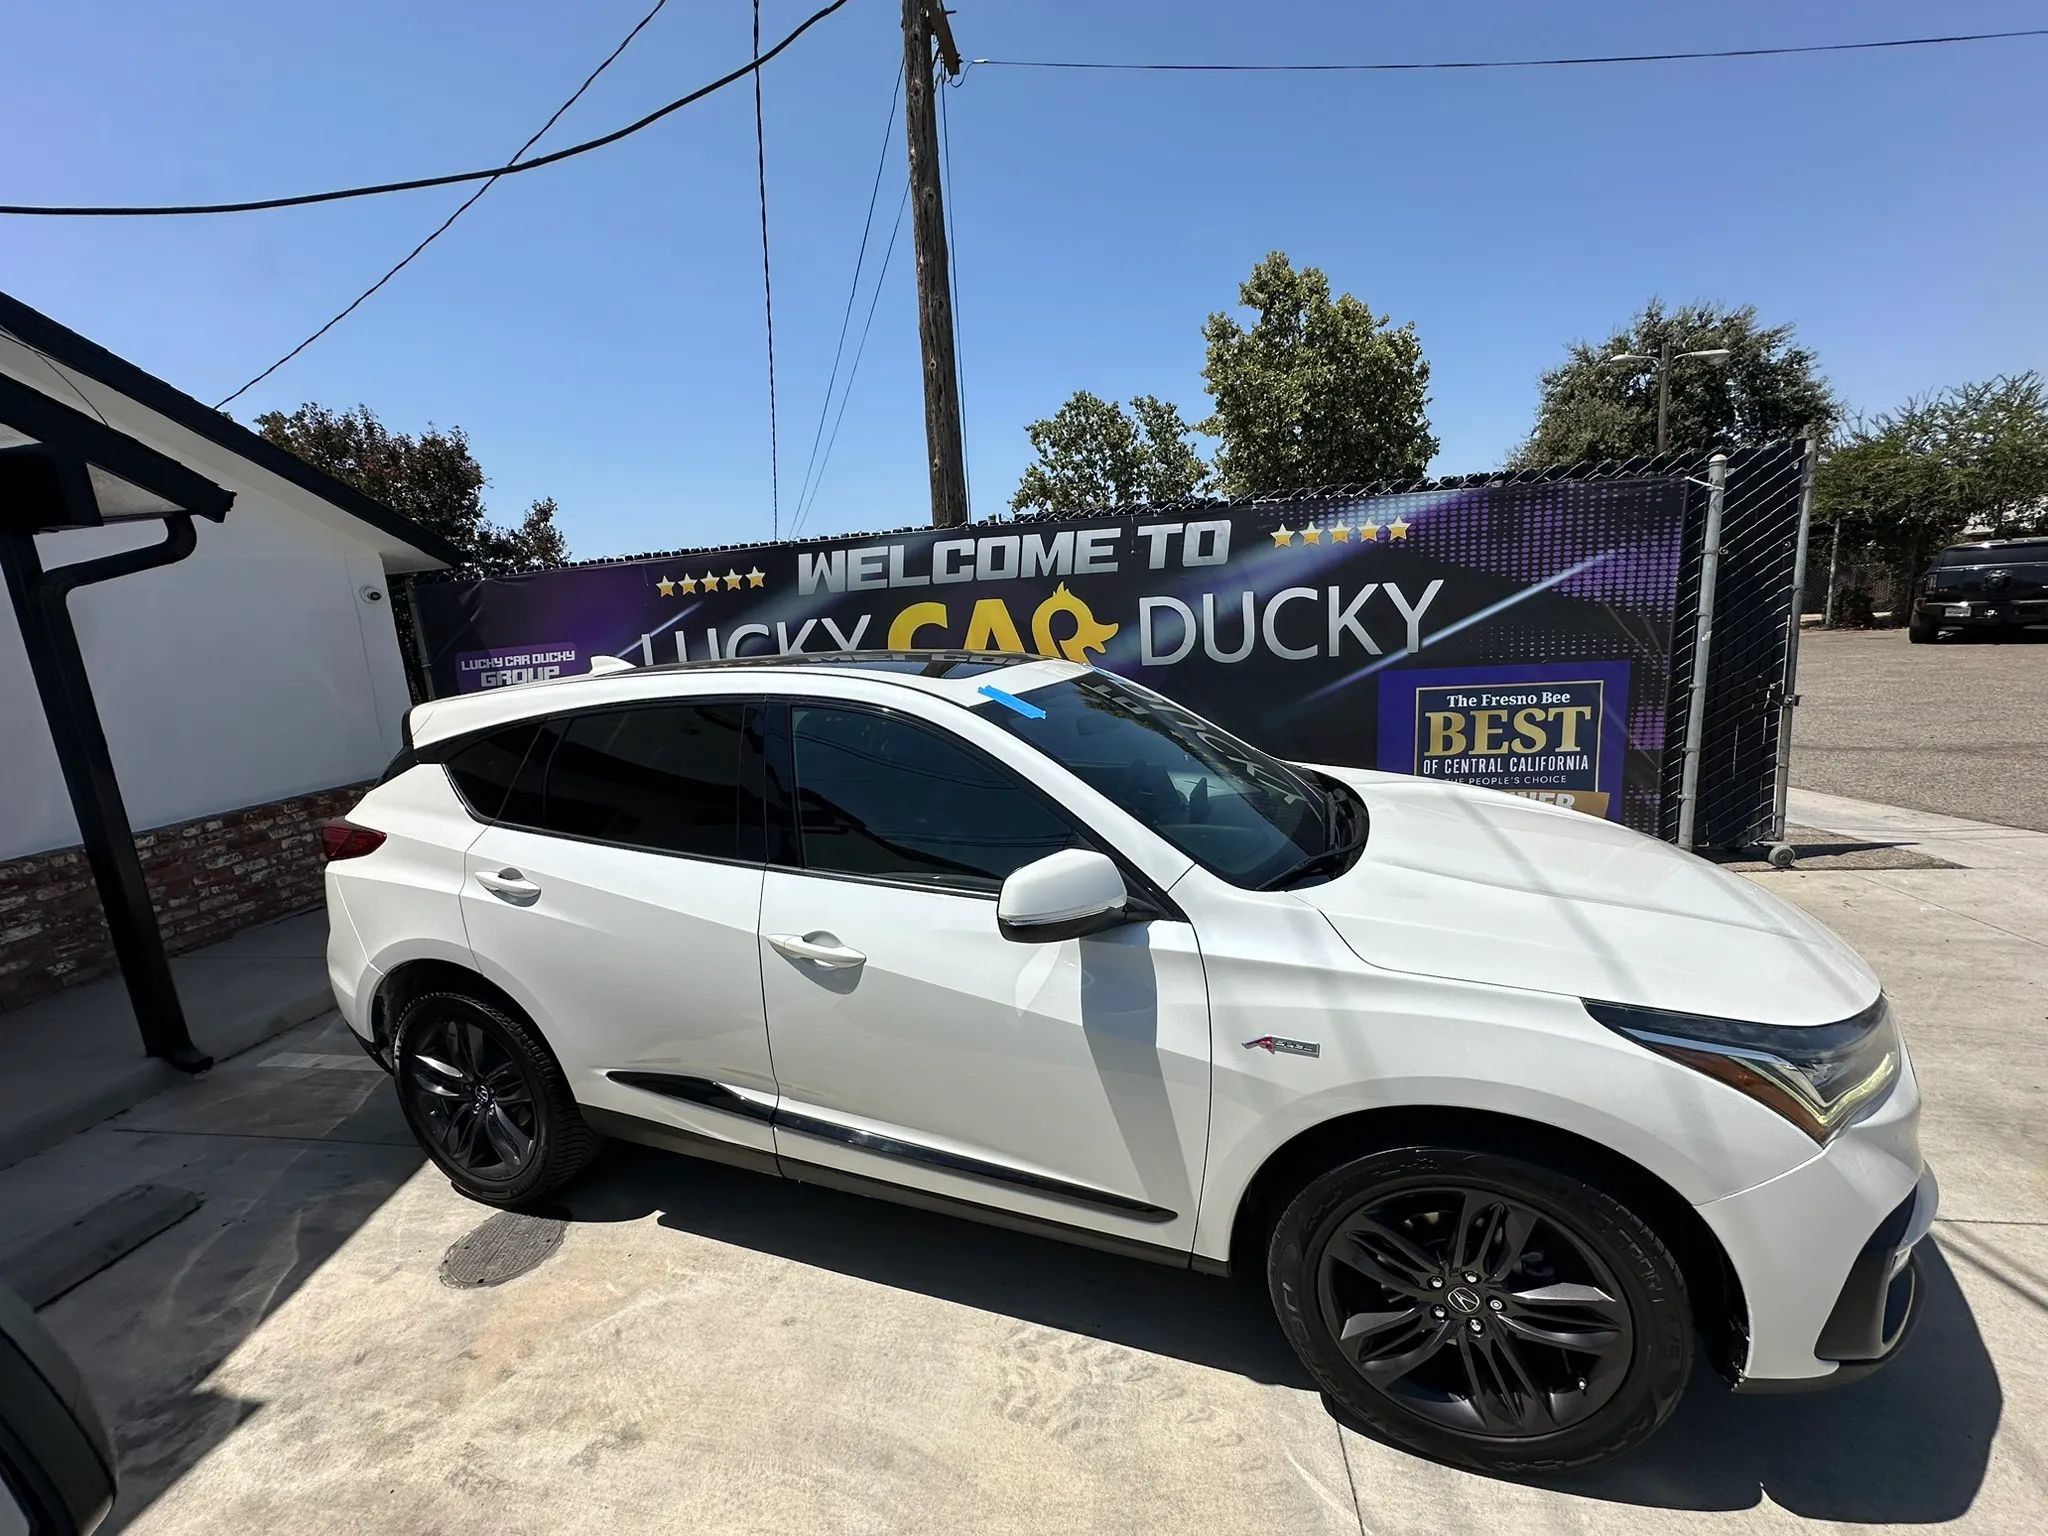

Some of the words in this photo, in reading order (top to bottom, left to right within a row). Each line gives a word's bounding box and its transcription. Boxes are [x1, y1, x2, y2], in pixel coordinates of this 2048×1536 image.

[799, 527, 1122, 596] WELCOME
[1138, 519, 1232, 570] TO
[1139, 579, 1444, 667] DUCKY
[461, 657, 502, 671] LUCKY
[505, 654, 530, 667] CAR
[532, 650, 575, 664] DUCKY
[481, 665, 560, 688] GROUP
[1447, 695, 1477, 708] The
[1481, 693, 1537, 706] Fresno
[1541, 692, 1571, 704] Bee
[1424, 706, 1592, 757] BEST
[1423, 759, 1439, 775] OF
[1444, 757, 1503, 774] CENTRAL
[1509, 755, 1589, 772] CALIFORNIA
[1469, 776, 1520, 786] PEOPLE'S
[1525, 775, 1567, 784] CHOICE
